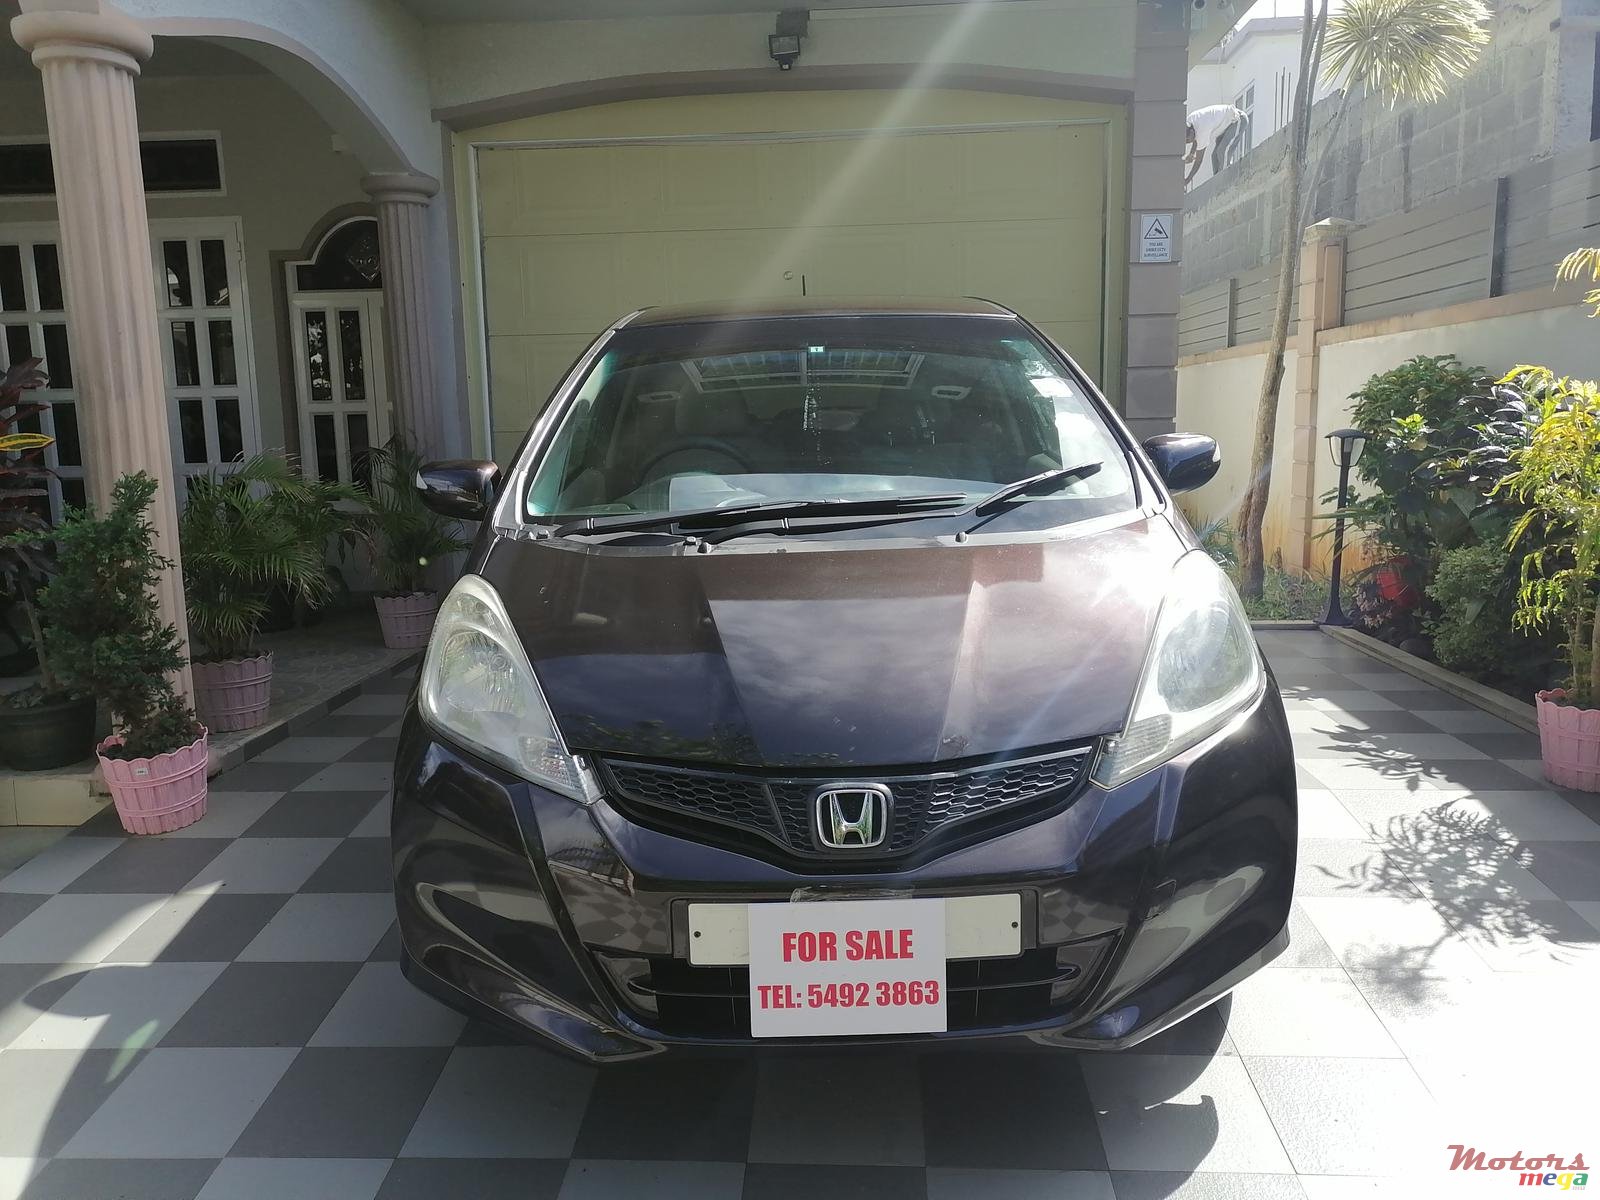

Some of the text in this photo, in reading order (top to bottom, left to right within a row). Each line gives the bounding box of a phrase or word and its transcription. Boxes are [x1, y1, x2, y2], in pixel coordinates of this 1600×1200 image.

[782, 928, 914, 963] FOR SALE
[757, 980, 939, 1009] TEL: 5492 3863
